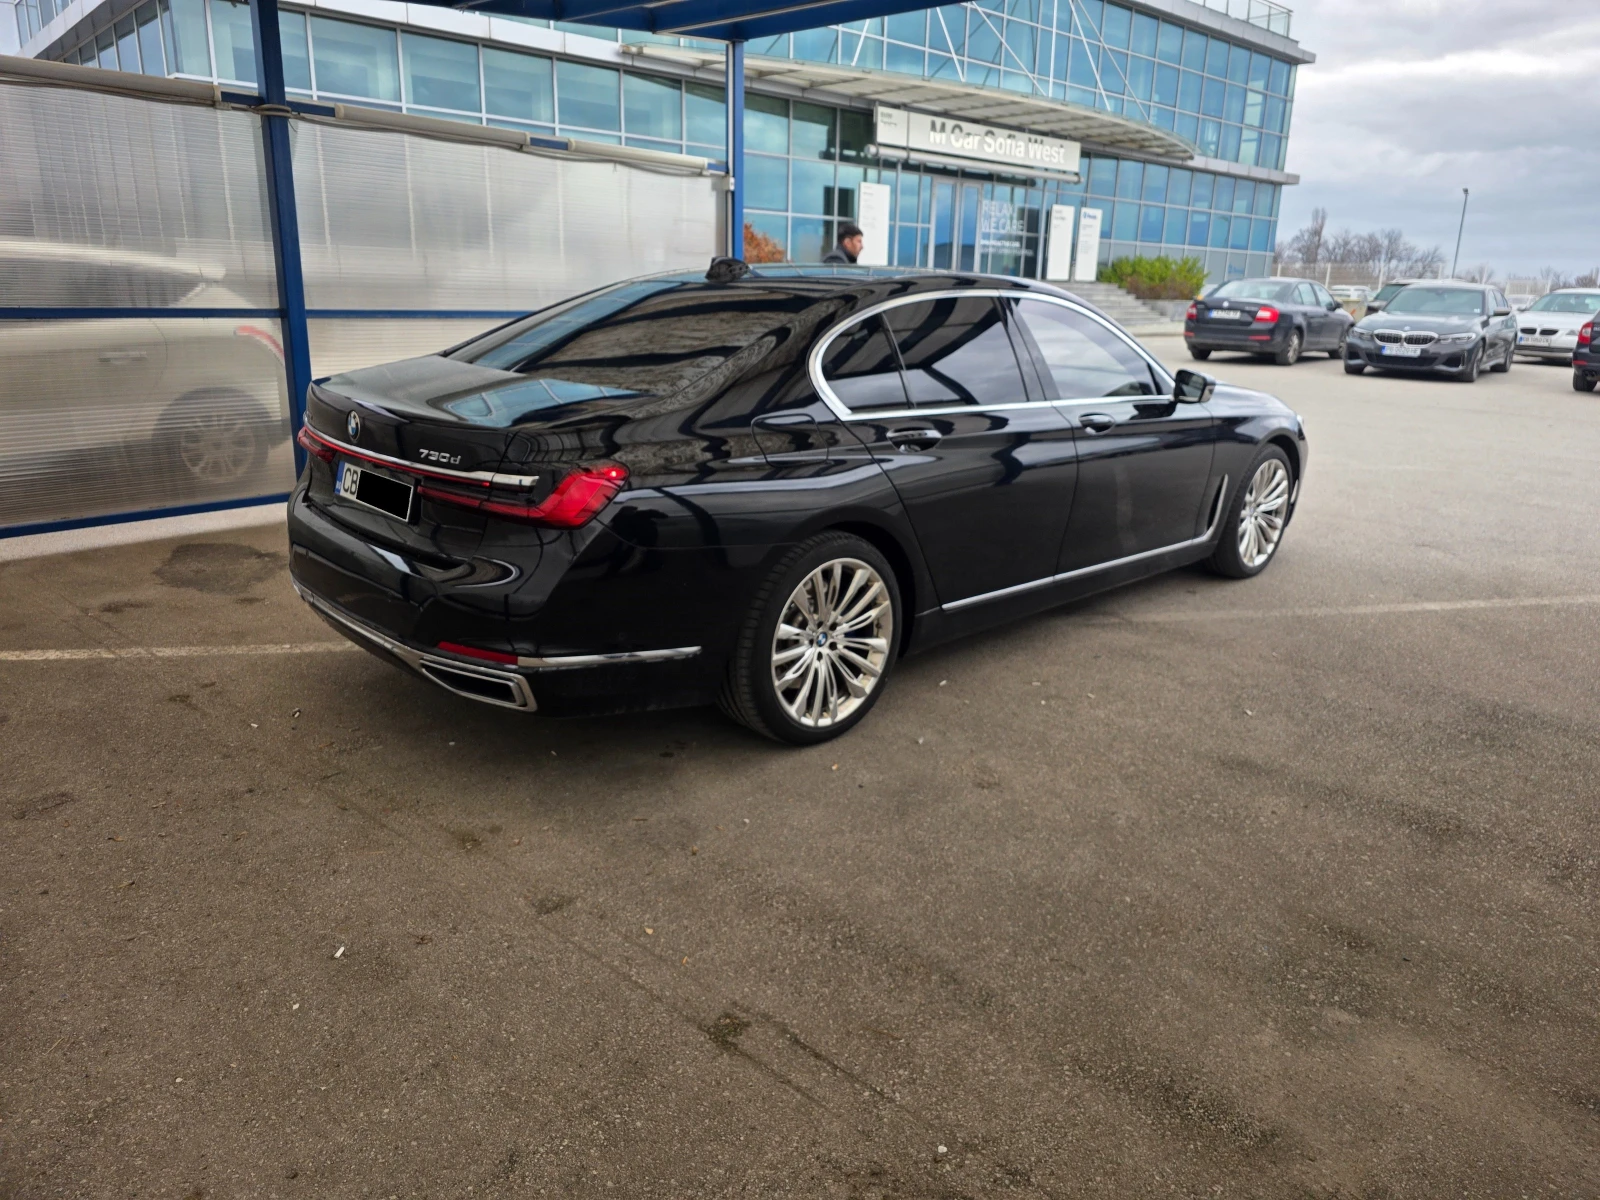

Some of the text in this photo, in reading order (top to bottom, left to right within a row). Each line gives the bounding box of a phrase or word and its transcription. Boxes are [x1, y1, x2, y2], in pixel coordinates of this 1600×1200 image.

[929, 119, 1066, 164] M Car Sofia West
[981, 199, 1016, 217] RELAX
[419, 448, 462, 465] 730d
